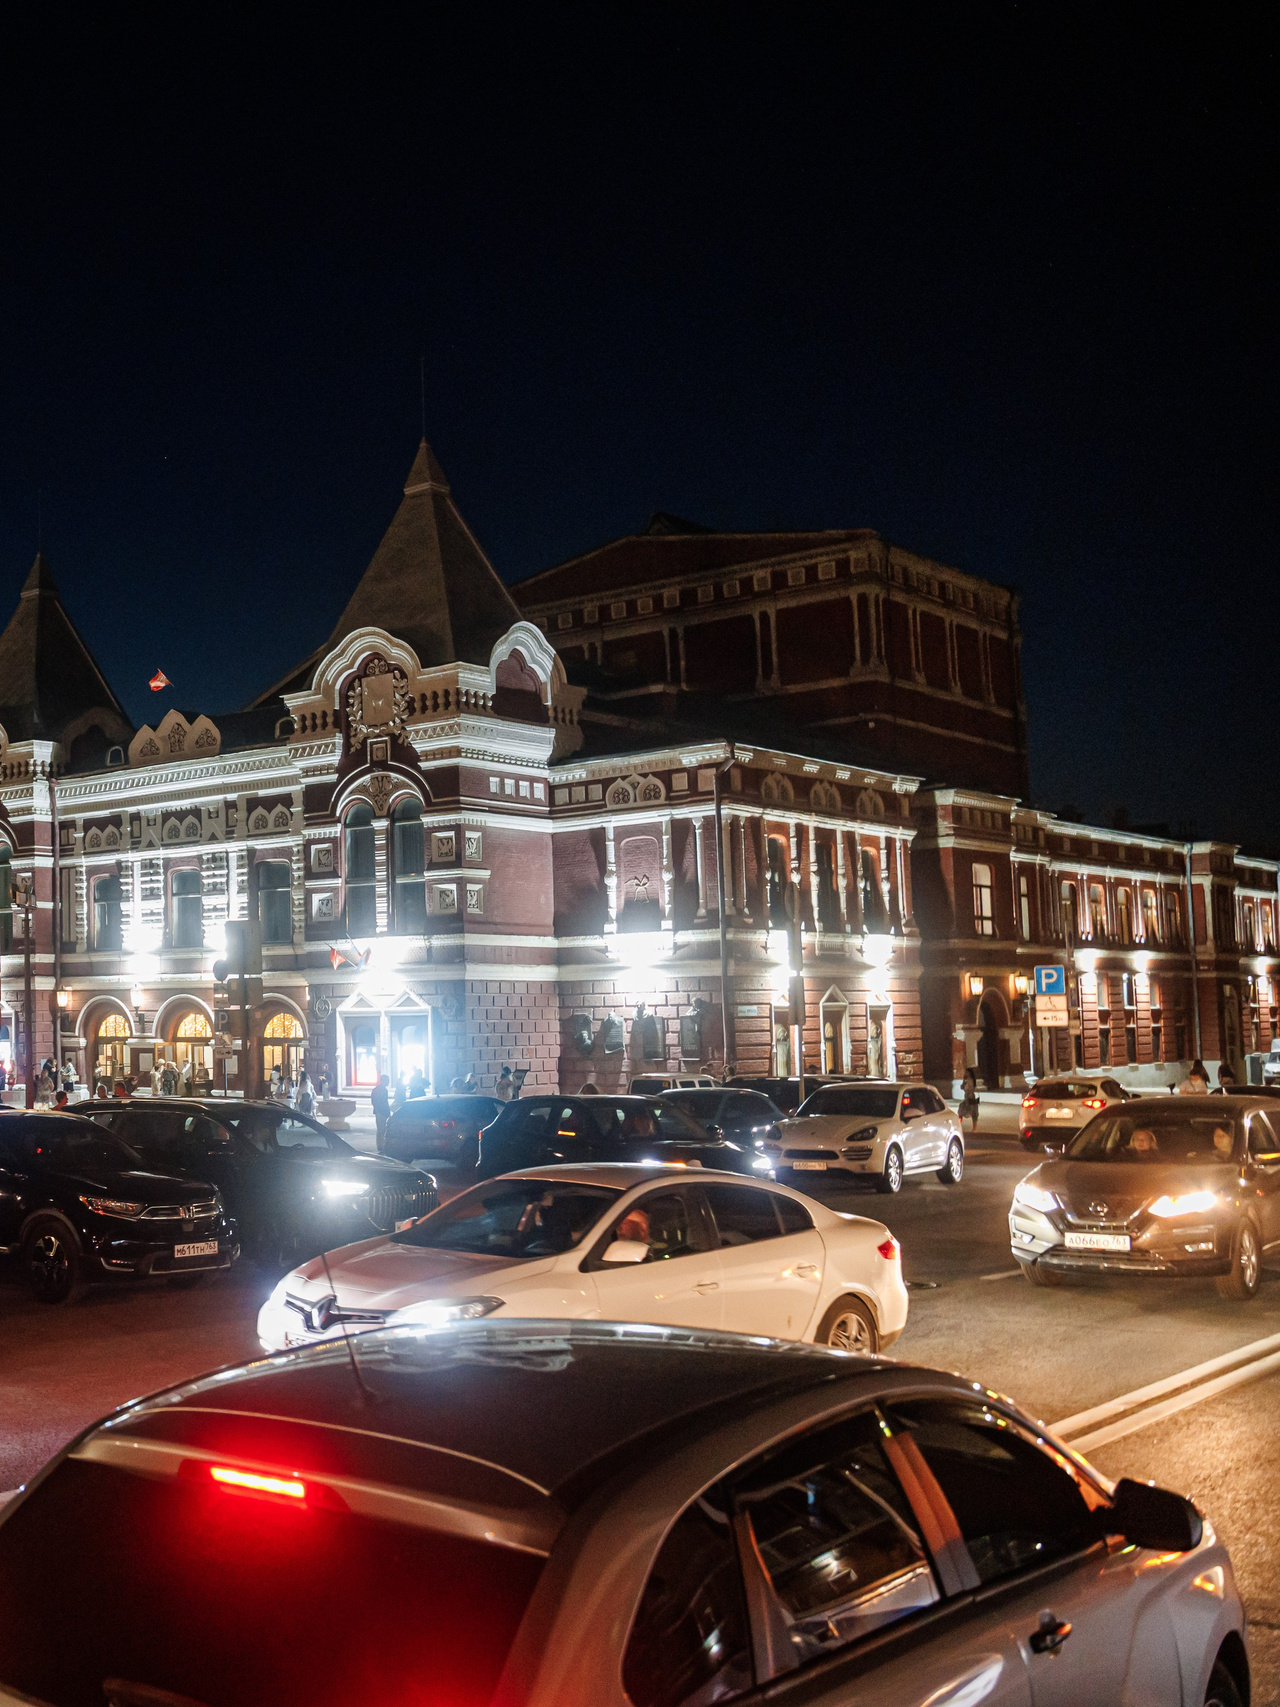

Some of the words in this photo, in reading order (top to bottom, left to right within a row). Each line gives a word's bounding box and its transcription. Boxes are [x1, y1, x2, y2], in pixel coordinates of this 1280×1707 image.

[1041, 968, 1058, 992] P
[219, 1011, 228, 1030] P
[205, 1242, 217, 1250] 763
